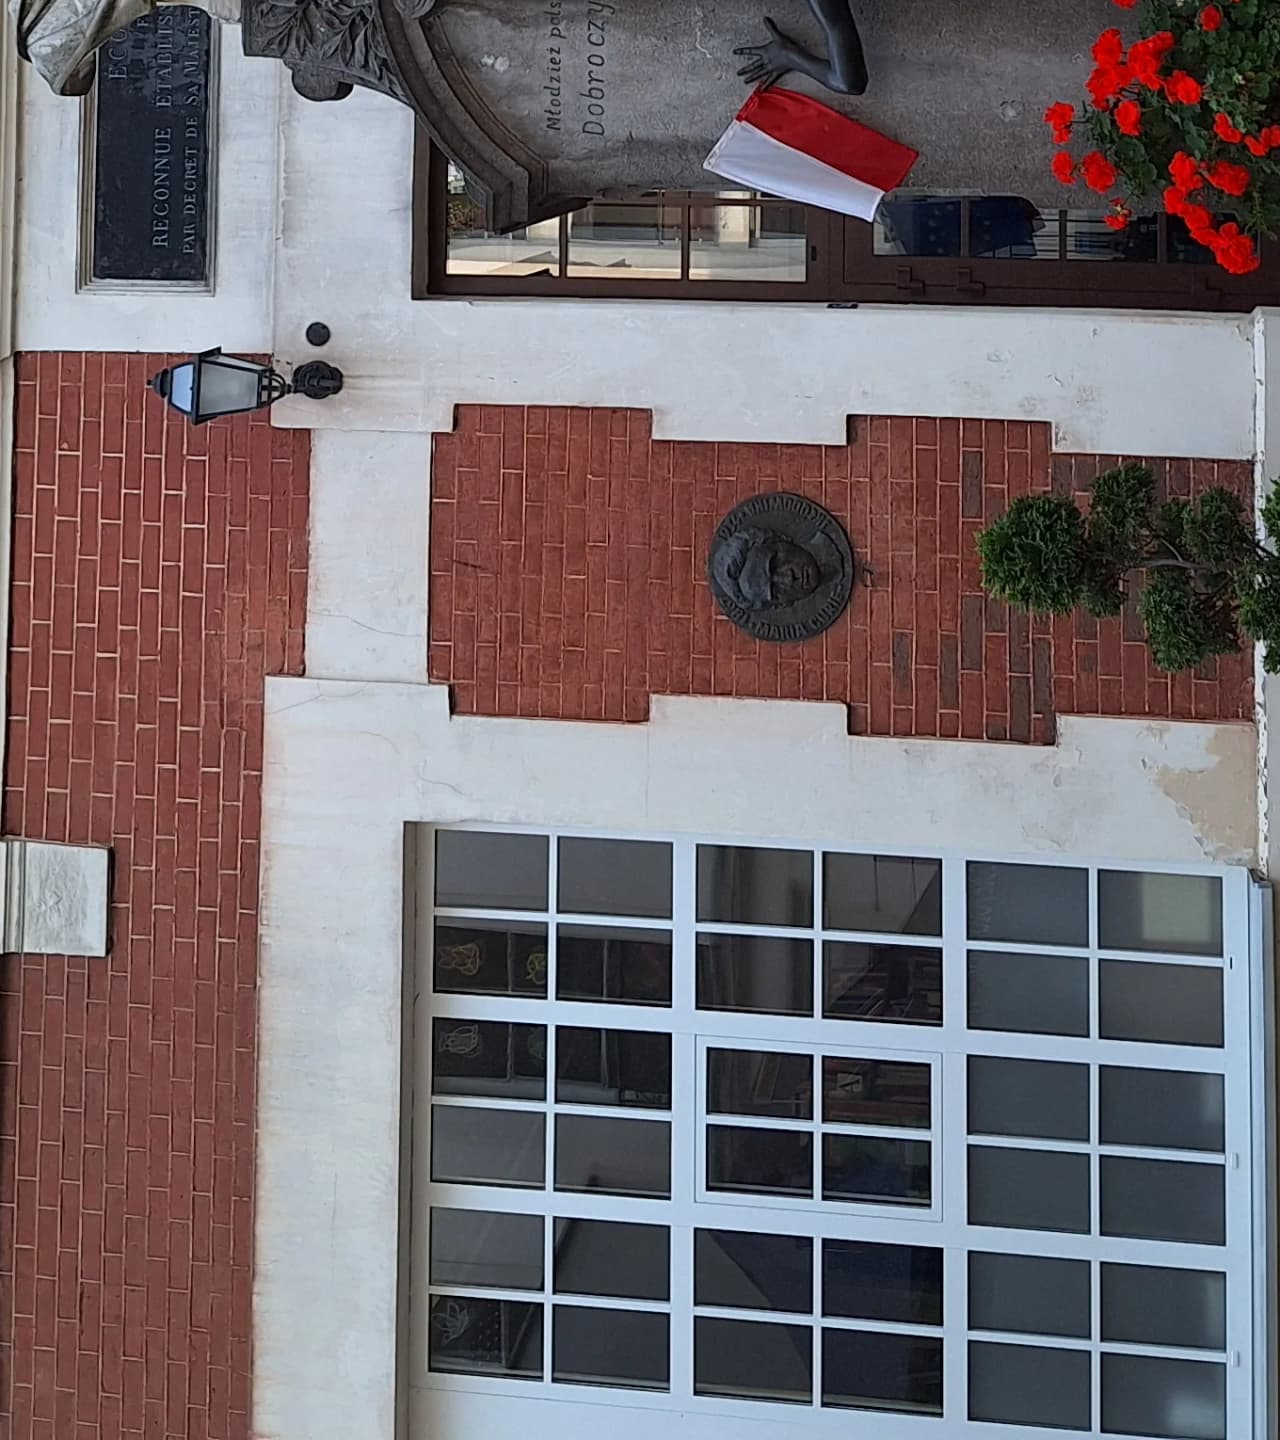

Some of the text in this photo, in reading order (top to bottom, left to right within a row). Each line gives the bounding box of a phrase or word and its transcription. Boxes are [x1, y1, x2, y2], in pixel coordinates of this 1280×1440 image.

[543, 46, 562, 130] Młodzież
[184, 116, 199, 139] DE
[152, 127, 173, 248] RECONNUE
[181, 223, 197, 254] PAR
